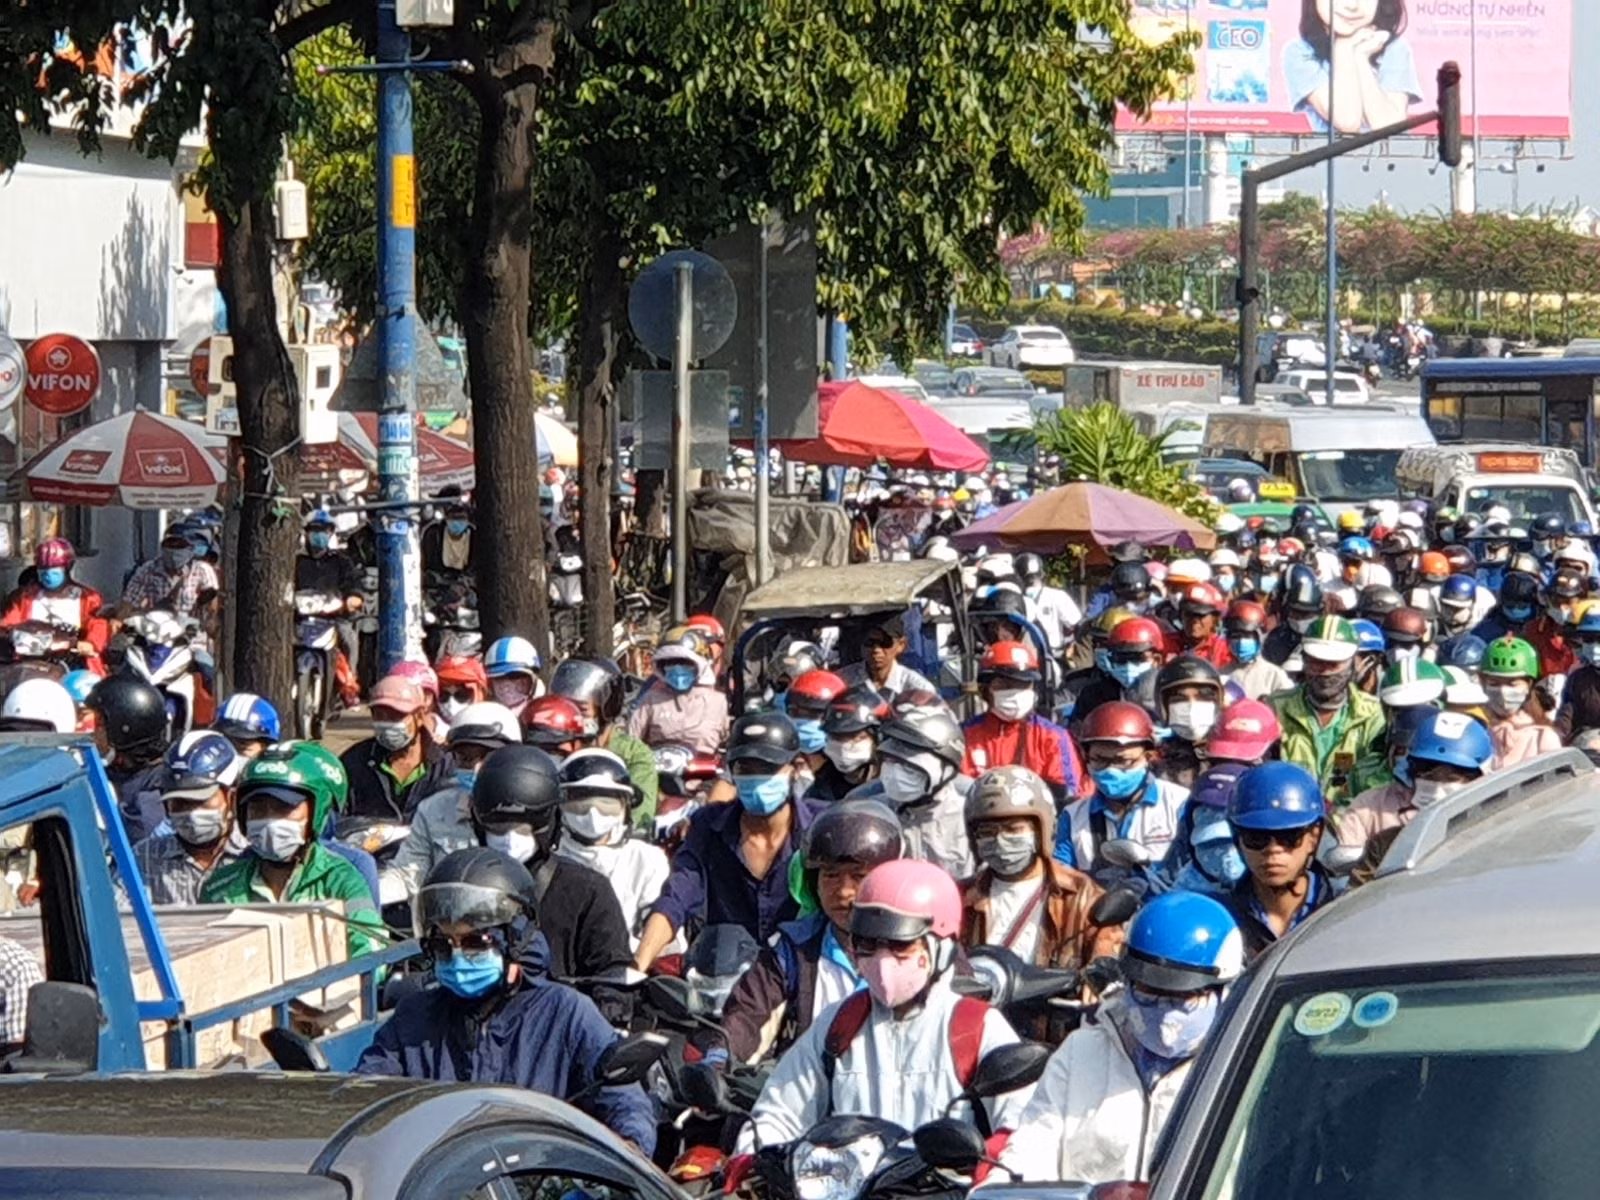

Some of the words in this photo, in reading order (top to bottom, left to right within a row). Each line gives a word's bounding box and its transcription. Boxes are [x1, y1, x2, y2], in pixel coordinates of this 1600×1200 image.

[1218, 28, 1260, 47] CEO
[28, 374, 91, 391] VIFON
[1137, 374, 1152, 387] XE
